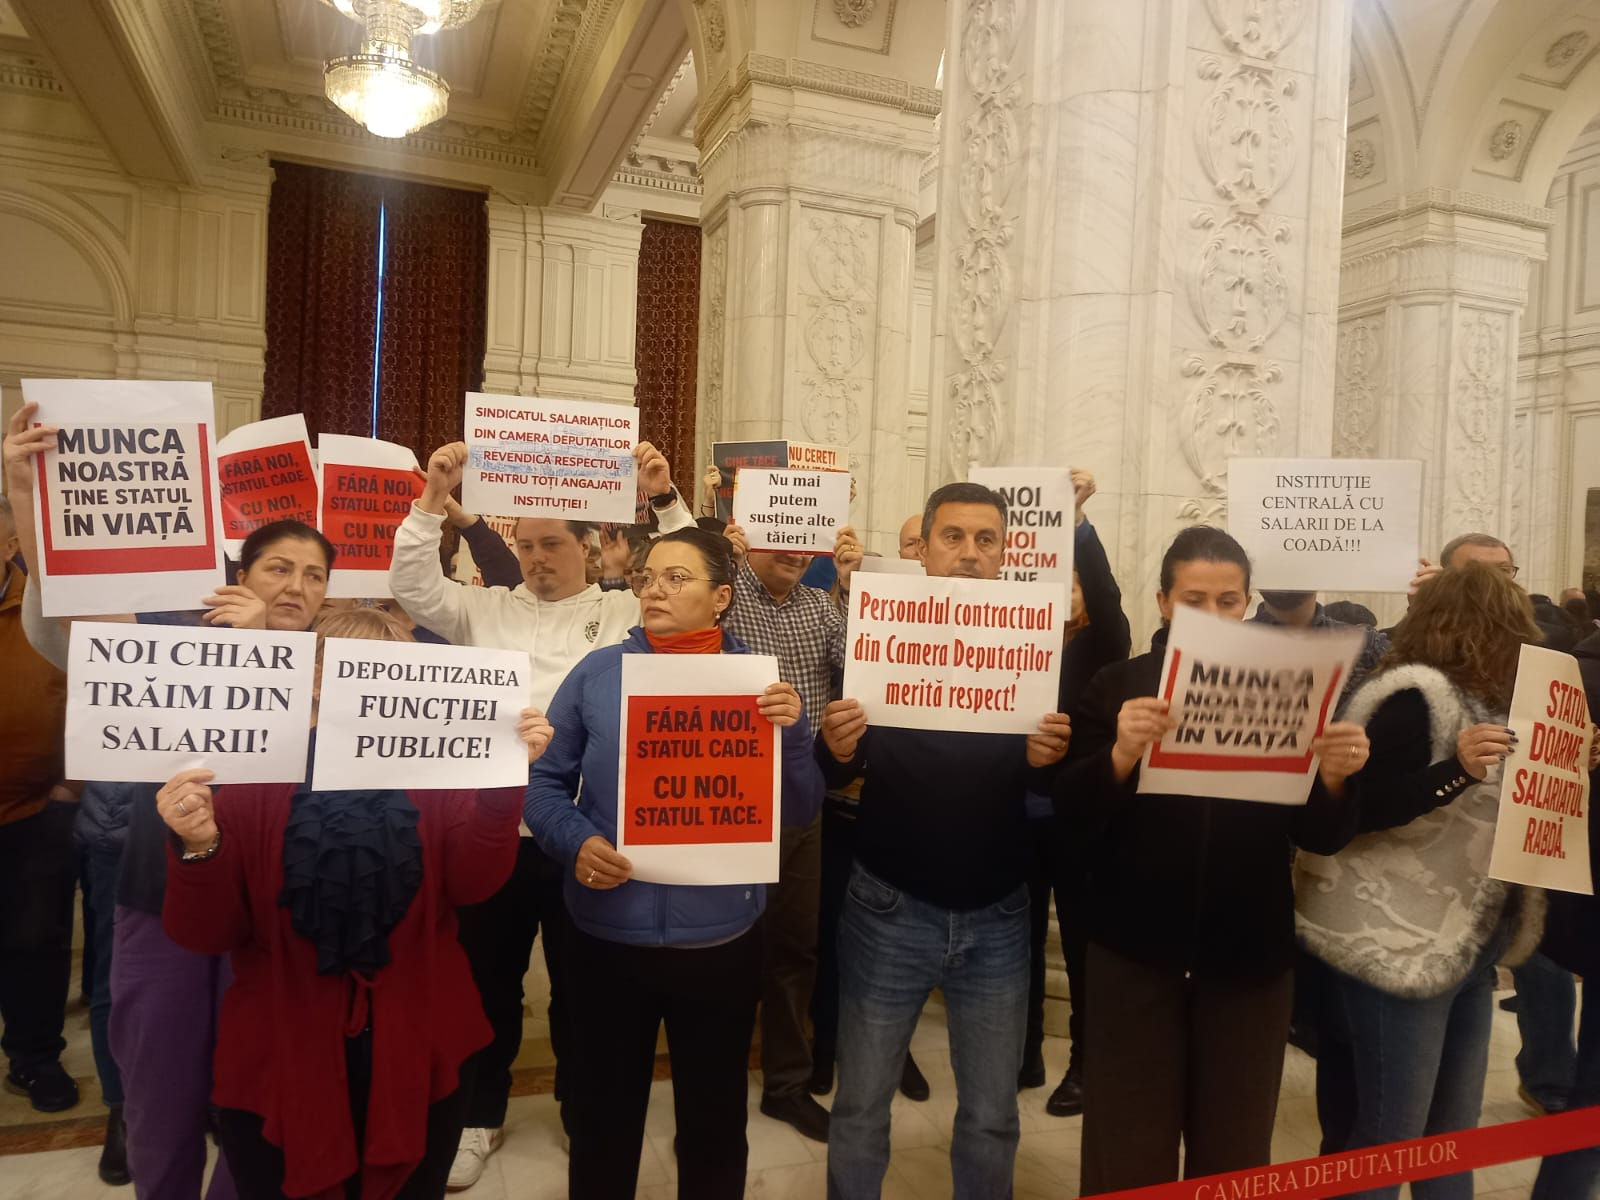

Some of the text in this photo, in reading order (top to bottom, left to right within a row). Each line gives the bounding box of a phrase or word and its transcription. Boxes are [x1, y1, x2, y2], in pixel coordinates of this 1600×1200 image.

[475, 407, 547, 423] SINDICATUL
[57, 428, 186, 455] MUNCA
[474, 429, 497, 440] DIN
[499, 430, 550, 444] CAMERA
[554, 456, 620, 470] RESPECTUL
[789, 446, 802, 461] NU
[224, 477, 270, 495] STATUL
[480, 472, 529, 485] PENTRU
[769, 474, 821, 487] Nu mai
[115, 488, 193, 505] STATUL
[331, 496, 411, 514] STATUL CAD
[769, 495, 818, 508] putem
[1000, 487, 1041, 508] NOI
[1262, 494, 1385, 511] CENTRALĂ CU
[241, 501, 263, 516] CU
[749, 512, 804, 528] susține
[807, 514, 836, 527] alte
[1261, 516, 1385, 531] SALARII DE LA
[344, 522, 397, 540] CU NO
[766, 531, 816, 545] tăieri !
[859, 591, 1053, 631] Personalul contractual
[87, 637, 295, 670] NOI CHIAR
[854, 633, 1053, 680] din Camera Deputaților
[337, 660, 520, 687] DEPOLITIZAREA
[85, 675, 293, 711] TRĂIM DIN
[885, 678, 1016, 714] merită respect!
[358, 694, 498, 726] FUNCȚIEI
[1546, 680, 1586, 729] STATUL
[709, 709, 757, 734] NOI,
[102, 725, 269, 754] SALARII!
[354, 735, 491, 759] PUBLICE!
[636, 738, 764, 759] STATUL CADE.
[653, 774, 745, 801] CU NOI,
[1512, 768, 1584, 818] SALARIATUL
[634, 805, 763, 827] STATUL TACE.
[1194, 1169, 1299, 1200] CAMERA
